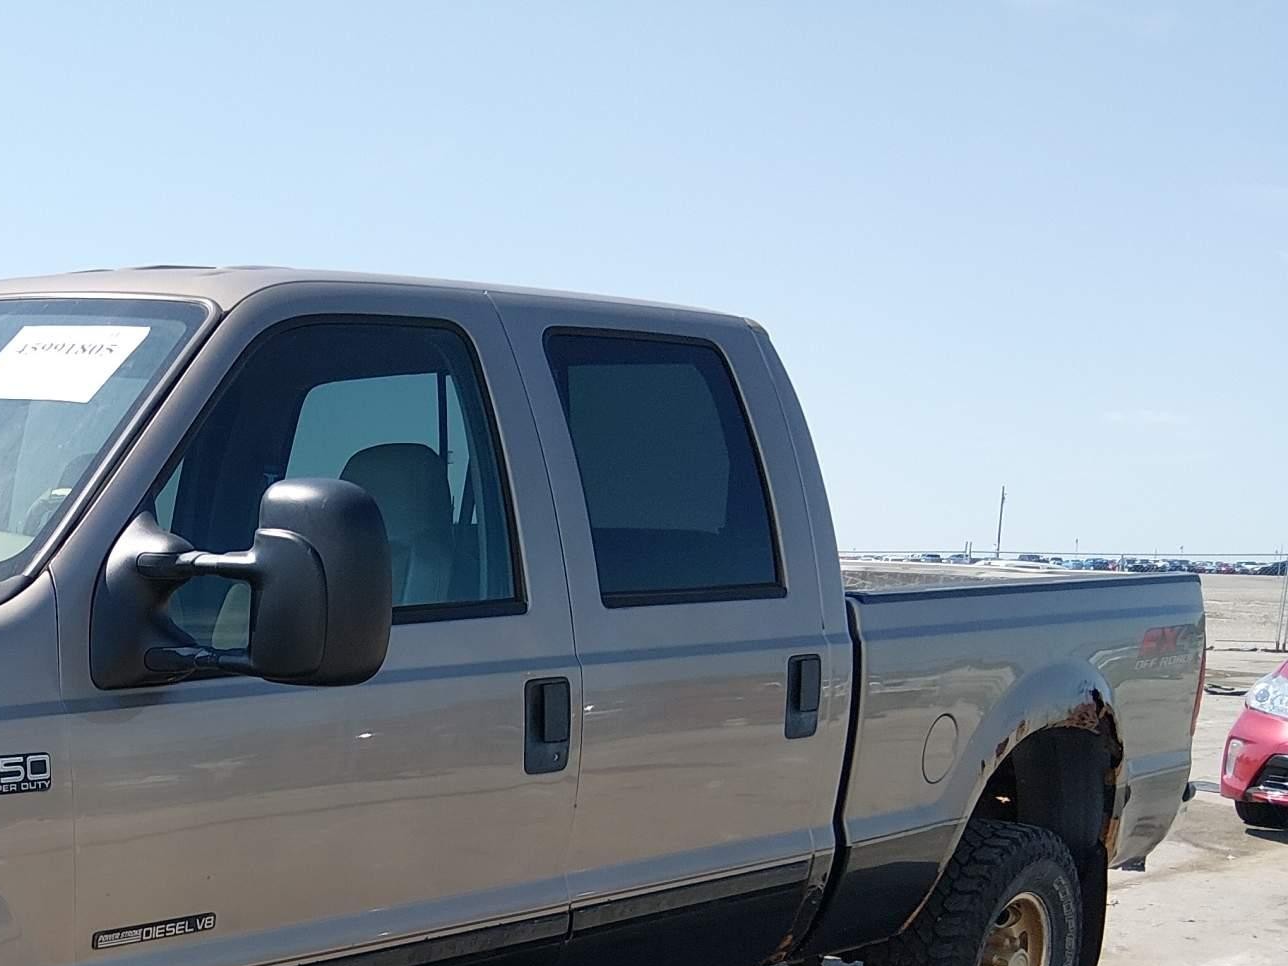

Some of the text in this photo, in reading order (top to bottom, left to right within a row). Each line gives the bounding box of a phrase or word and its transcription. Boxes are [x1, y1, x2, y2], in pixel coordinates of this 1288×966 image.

[1135, 659, 1156, 670] OFF
[21, 780, 51, 790] DUTY
[142, 921, 194, 941] DIESEL
[196, 916, 214, 930] V8
